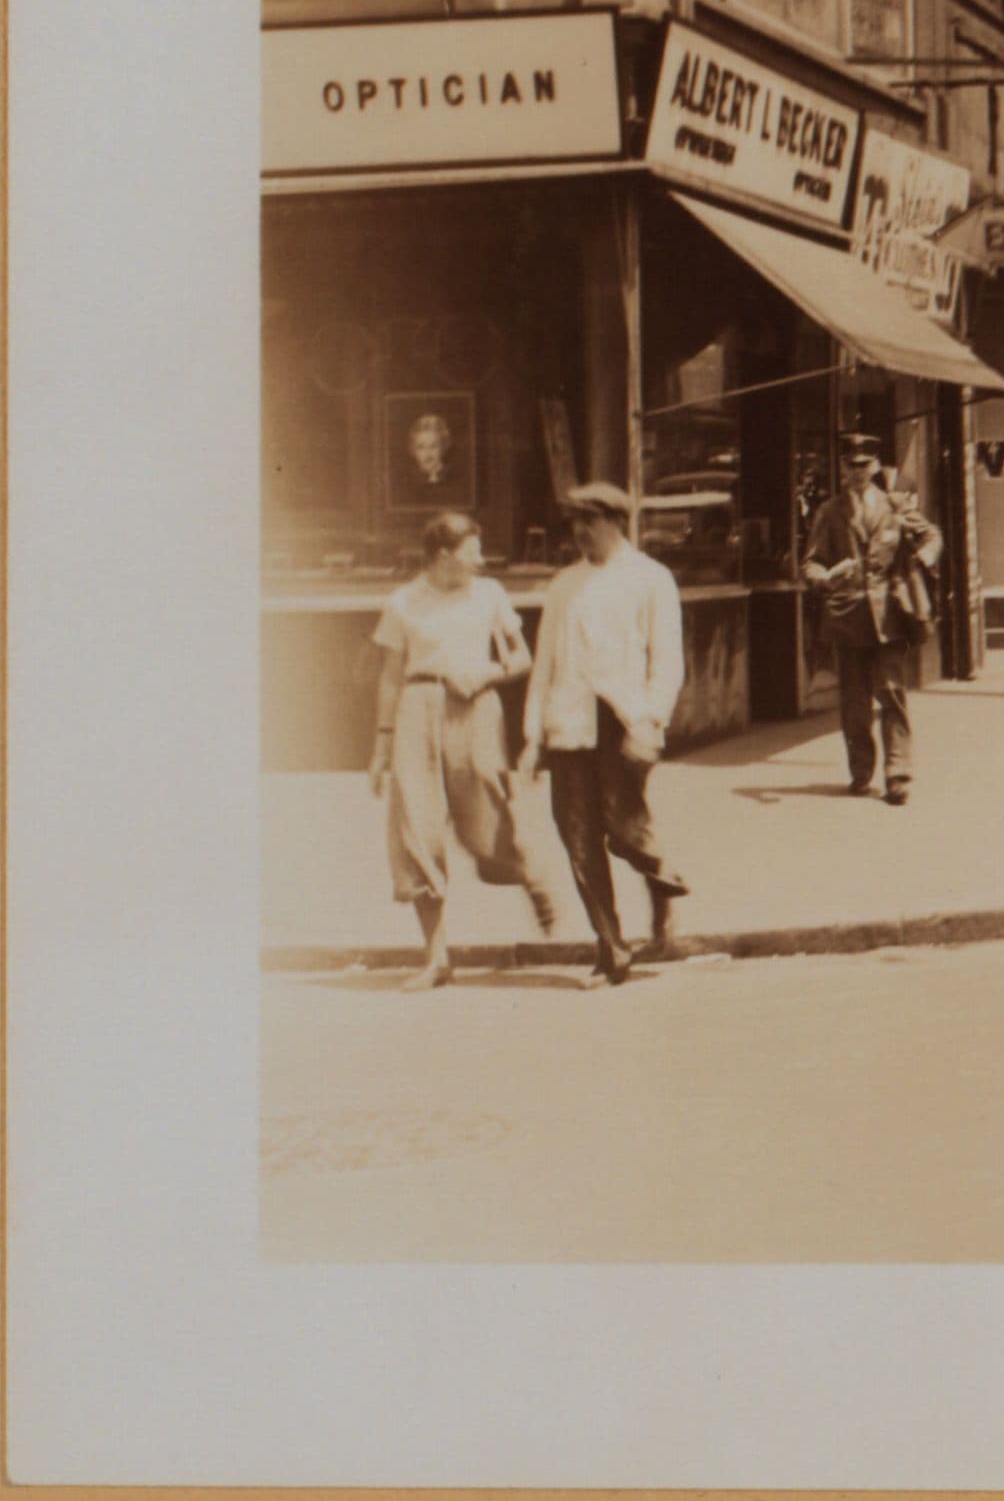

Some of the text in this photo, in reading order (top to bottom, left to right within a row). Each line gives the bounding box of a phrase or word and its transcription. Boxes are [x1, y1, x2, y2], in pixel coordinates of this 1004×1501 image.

[322, 69, 557, 114] OPTICIAN
[669, 47, 759, 134] ALBERT
[776, 95, 849, 171] BECKER
